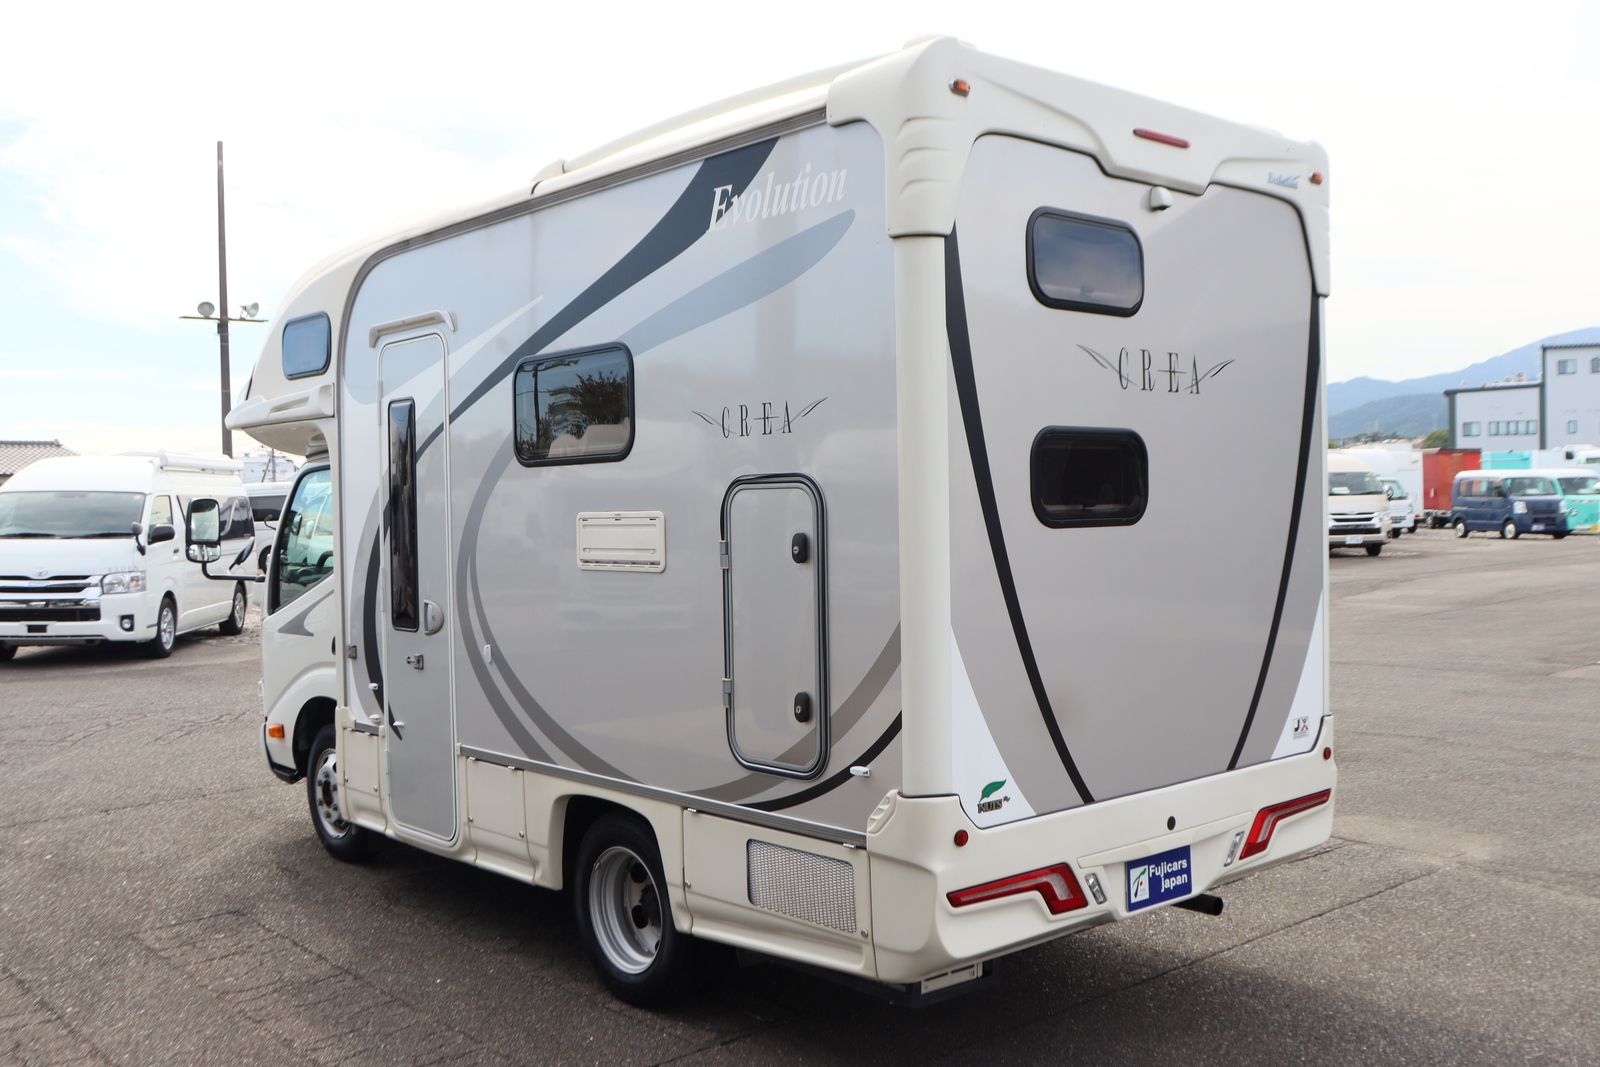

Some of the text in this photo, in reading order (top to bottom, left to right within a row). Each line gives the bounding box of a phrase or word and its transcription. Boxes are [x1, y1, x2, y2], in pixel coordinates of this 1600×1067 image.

[706, 162, 848, 233] Evolution
[1118, 347, 1201, 394] CREA
[721, 400, 793, 438] CREA
[977, 799, 1003, 814] NUTS
[1149, 859, 1188, 877] Fujicars
